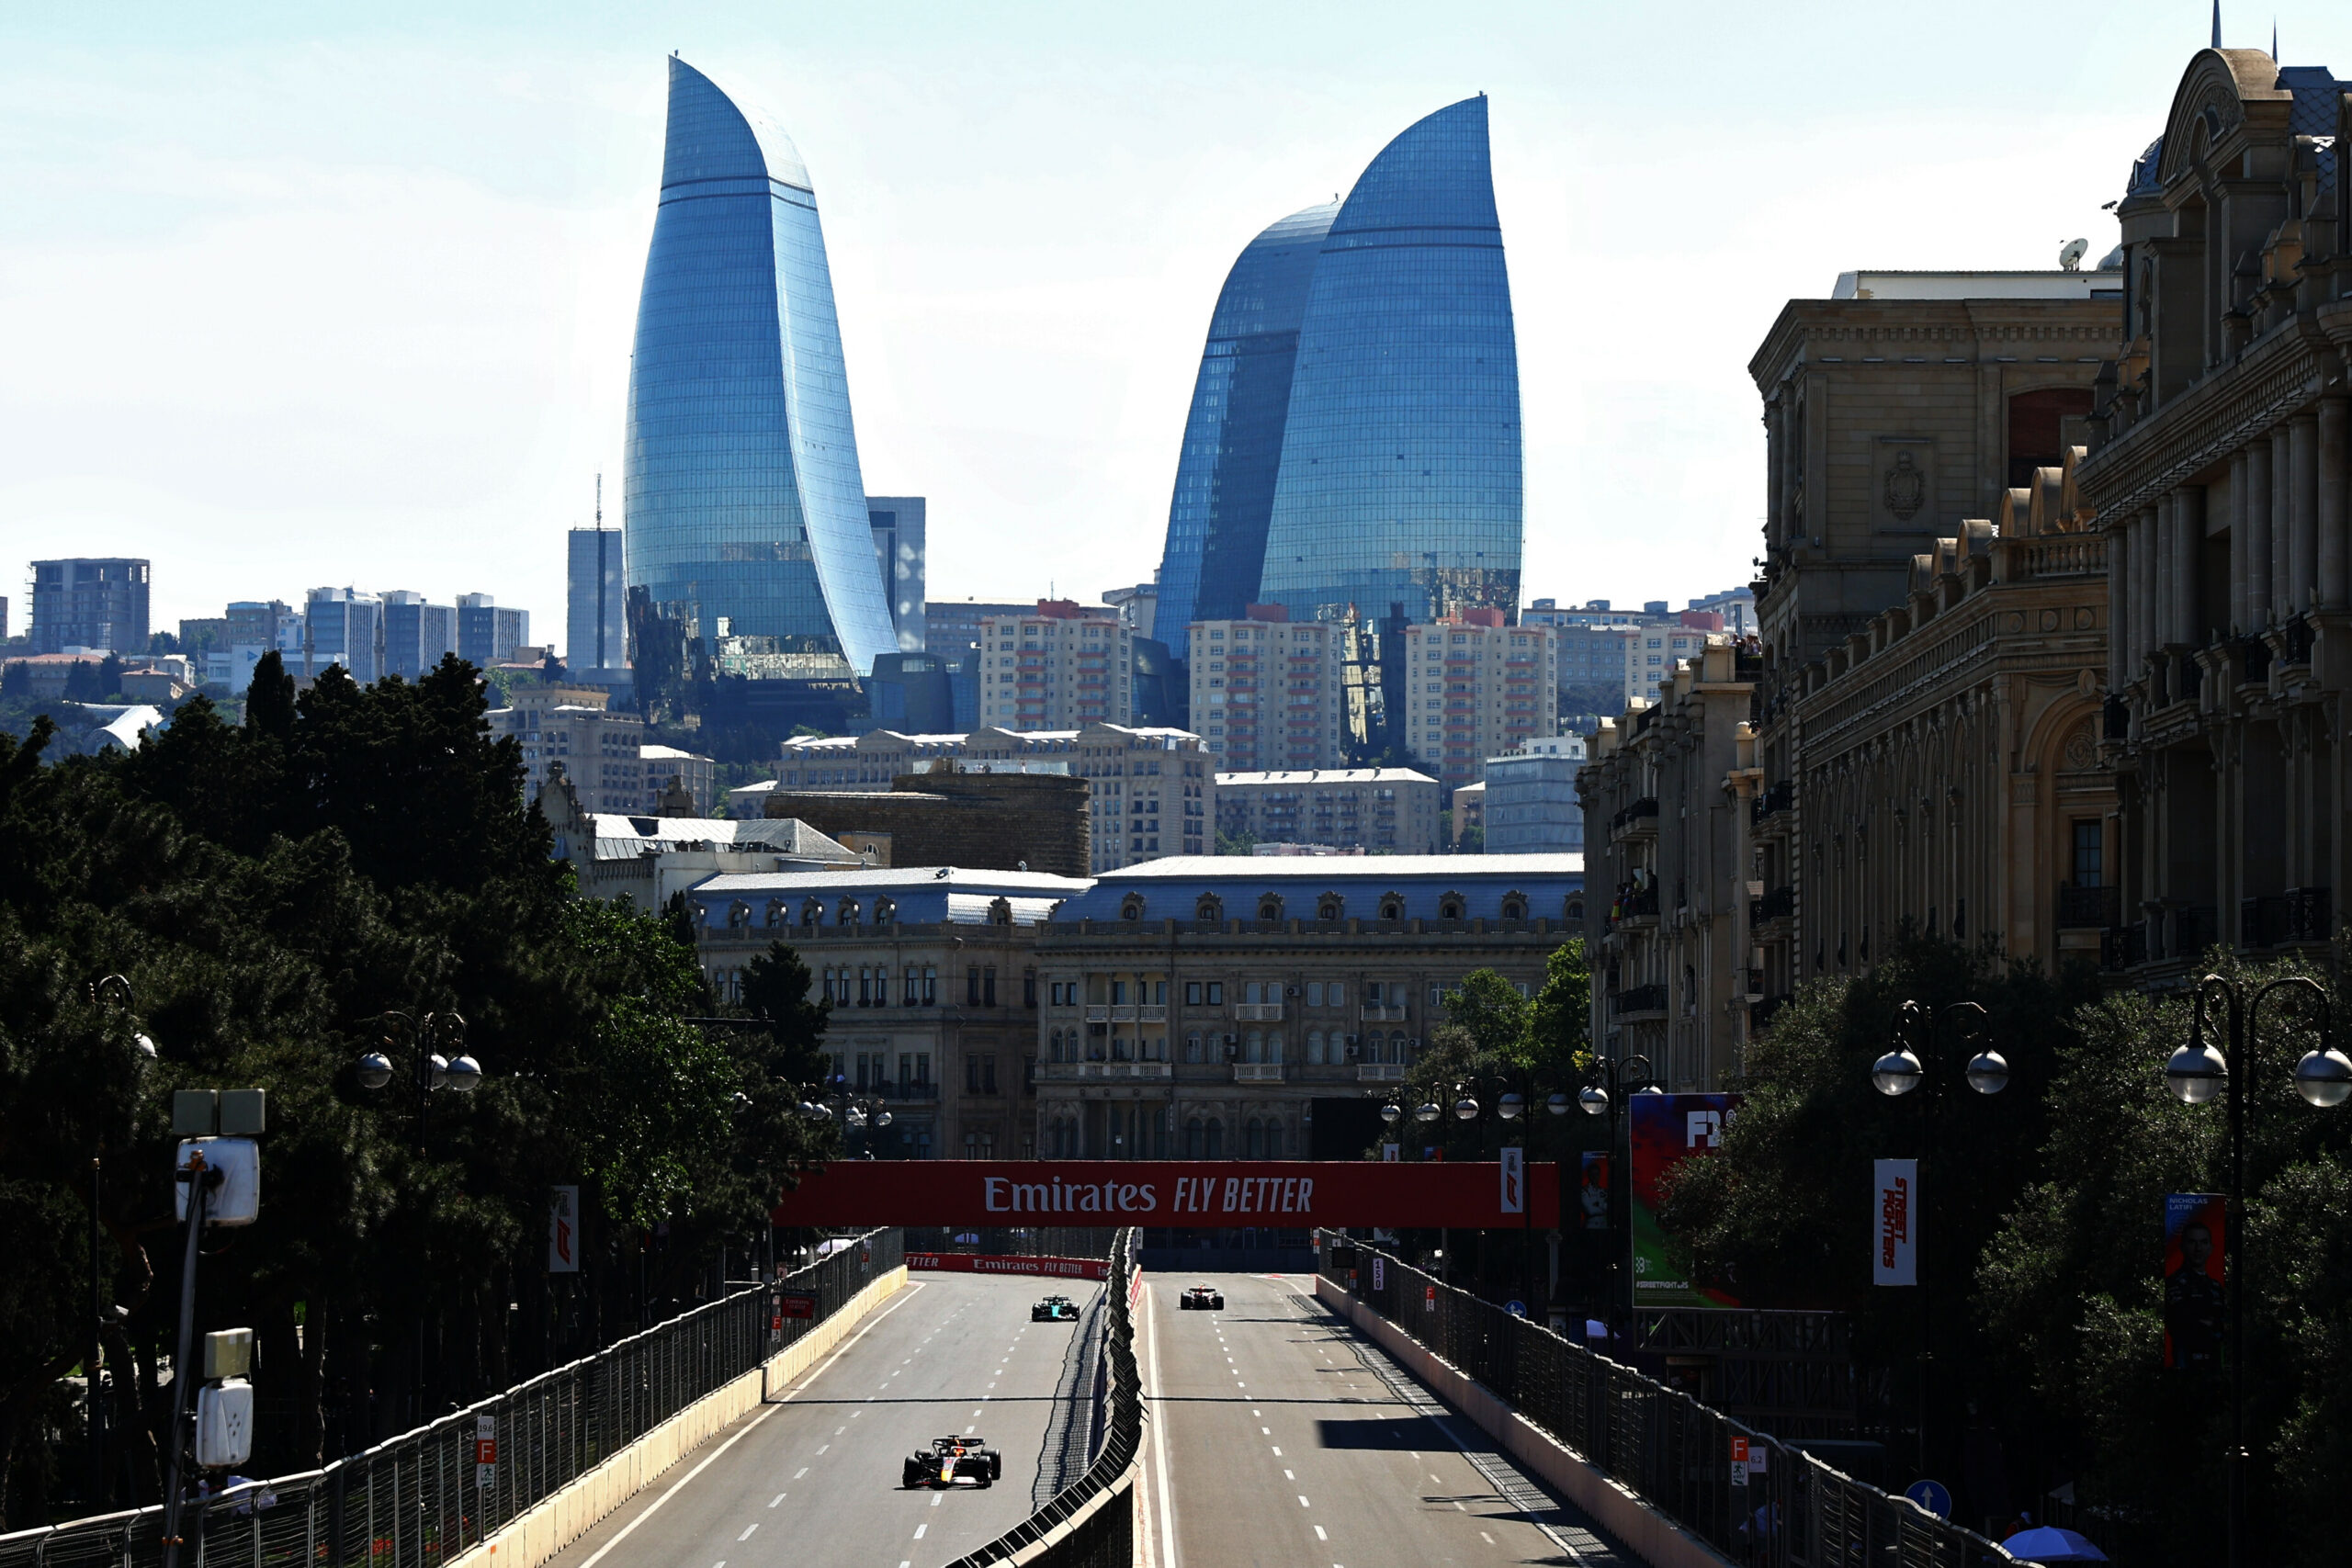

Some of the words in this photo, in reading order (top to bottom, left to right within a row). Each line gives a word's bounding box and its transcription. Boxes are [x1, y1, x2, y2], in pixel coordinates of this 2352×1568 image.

[984, 1176, 1157, 1213] Emirates
[1173, 1178, 1216, 1213] FLY
[1223, 1178, 1314, 1213] BETTER
[1894, 1176, 1907, 1244] STREET
[1883, 1189, 1895, 1269] FIGHTERS
[906, 1257, 939, 1267] ETTER
[973, 1258, 1039, 1271] Emirates
[1044, 1262, 1057, 1273] FLY
[1059, 1263, 1082, 1275] BETTER
[479, 1425, 493, 1433] 19.6
[481, 1442, 493, 1461] F
[1734, 1439, 1746, 1459] F
[1750, 1455, 1762, 1463] 6.2
